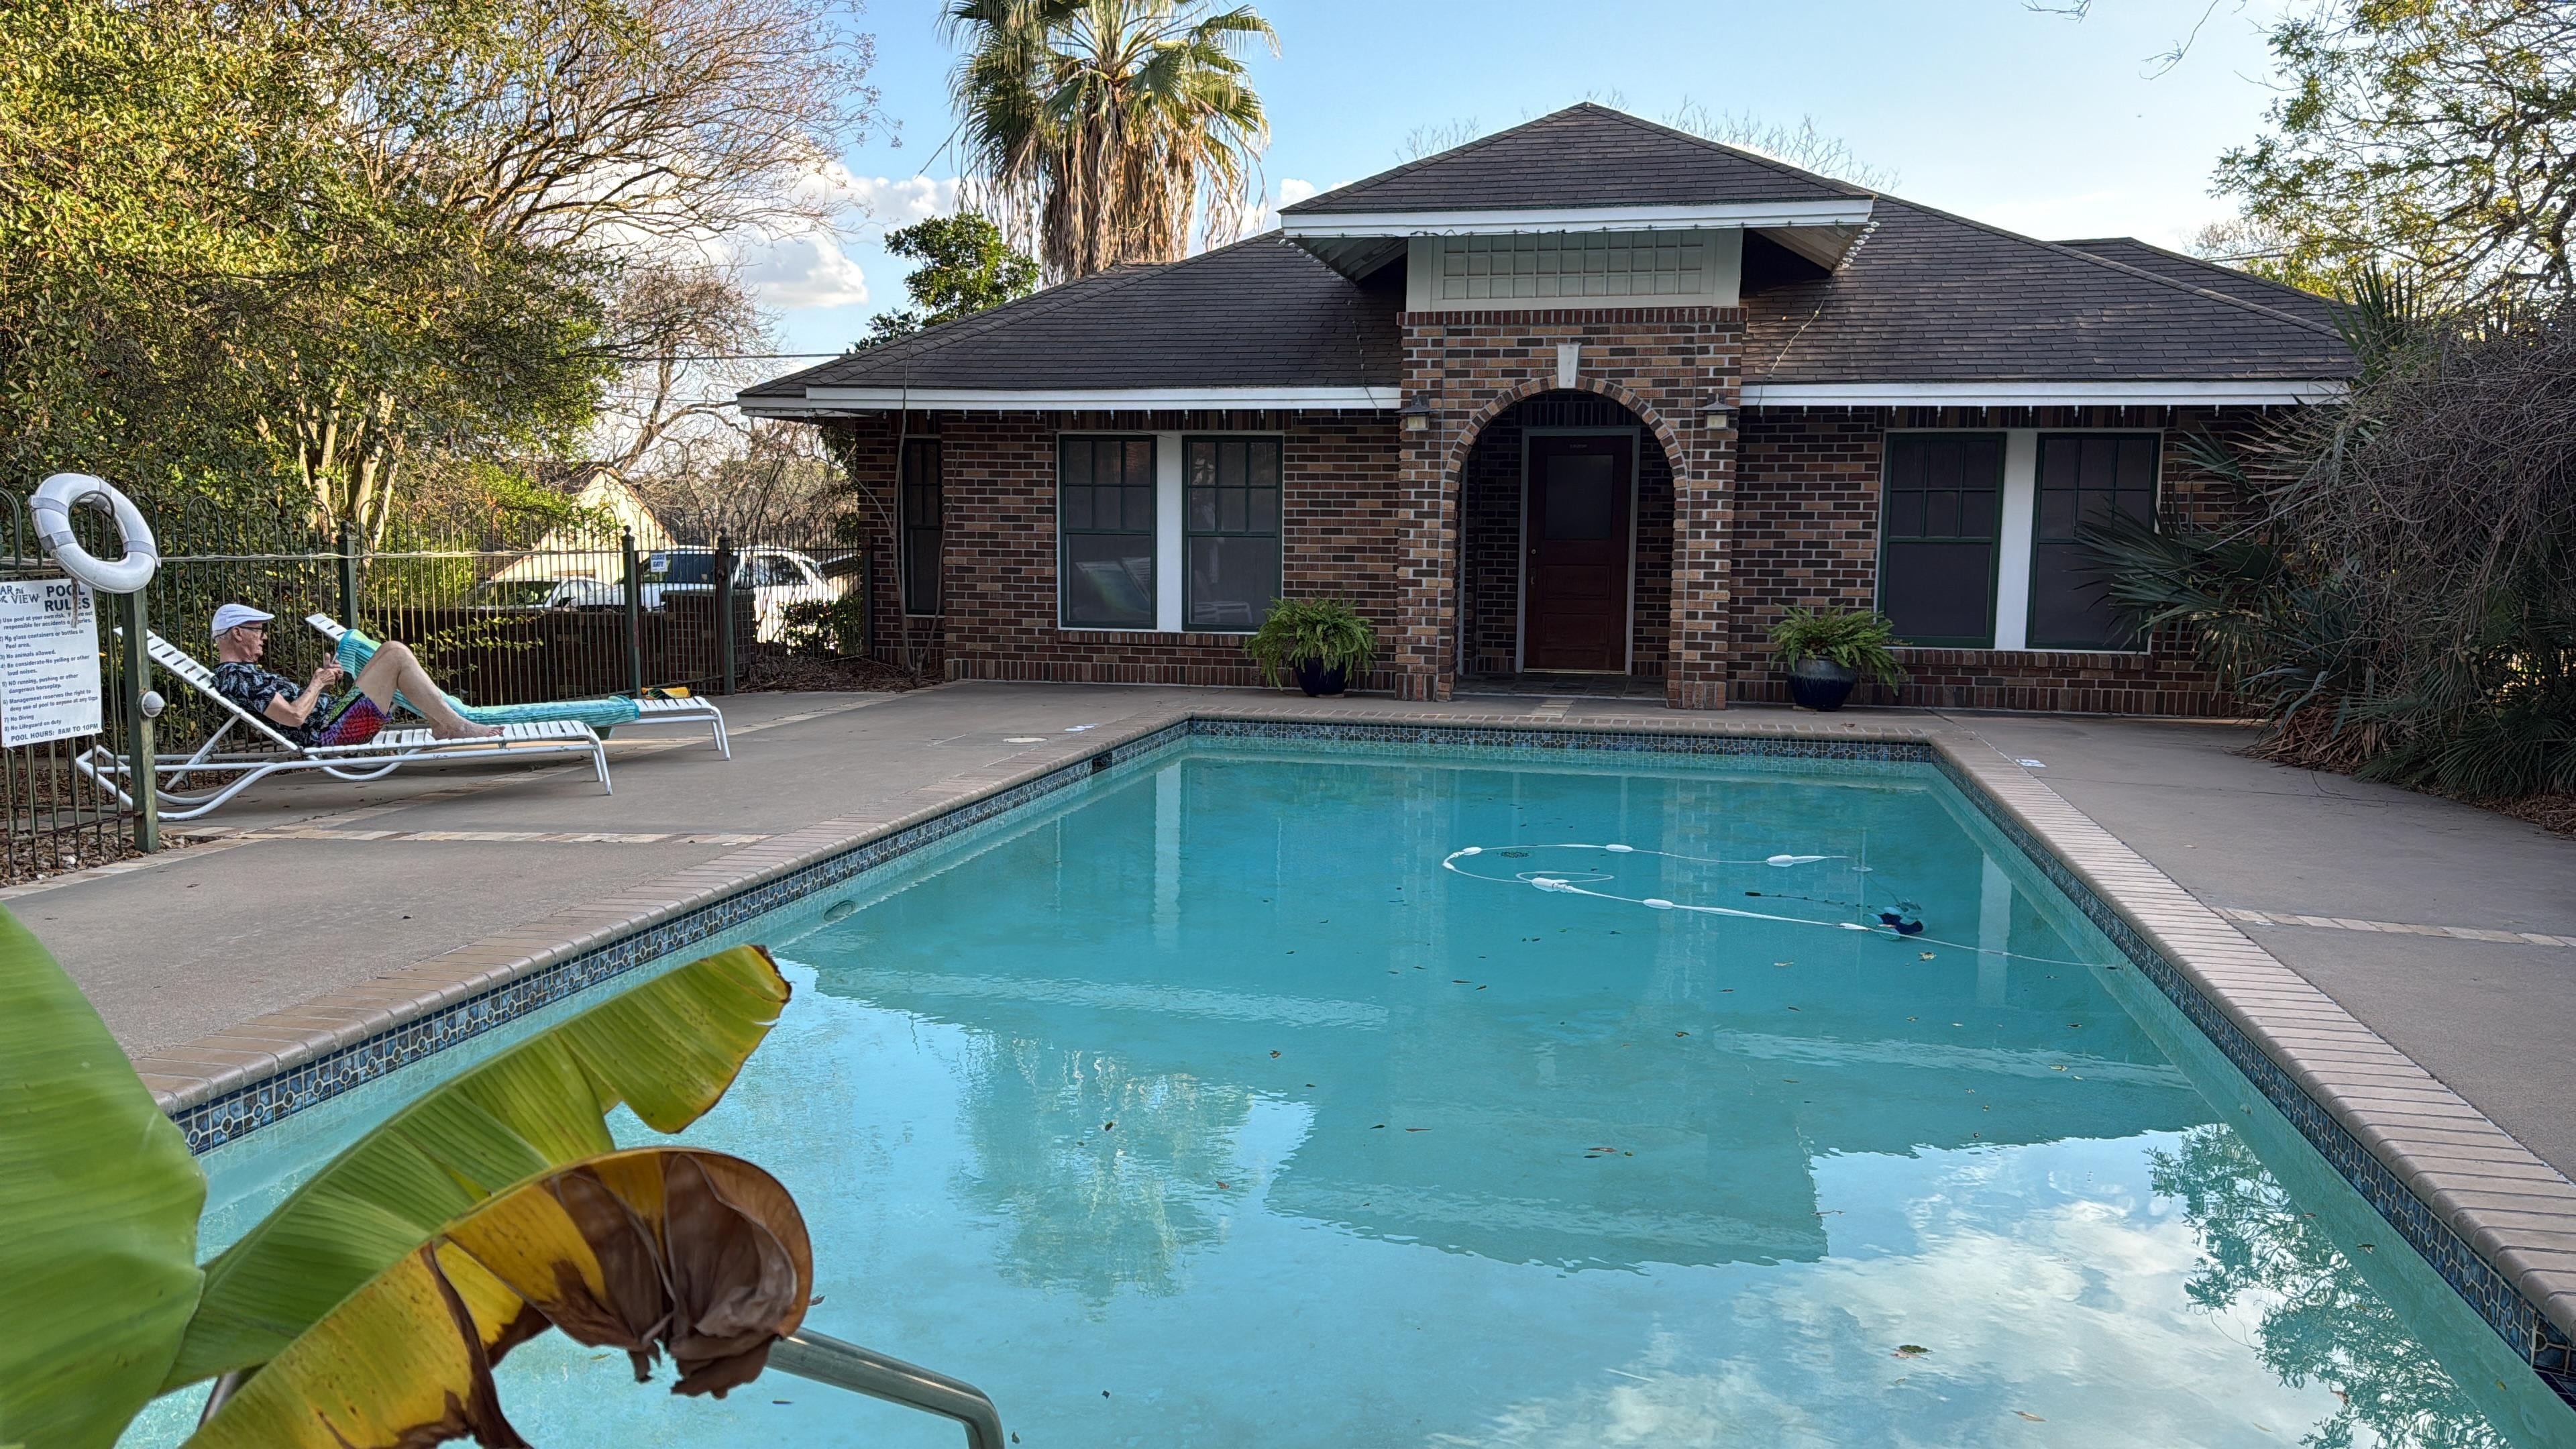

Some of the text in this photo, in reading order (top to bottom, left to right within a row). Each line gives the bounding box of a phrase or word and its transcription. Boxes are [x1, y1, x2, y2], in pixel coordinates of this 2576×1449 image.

[11, 594, 39, 604] VIEW
[9, 696, 41, 704] Management
[19, 721, 42, 729] Lifeguard
[31, 731, 54, 739] HOURS:
